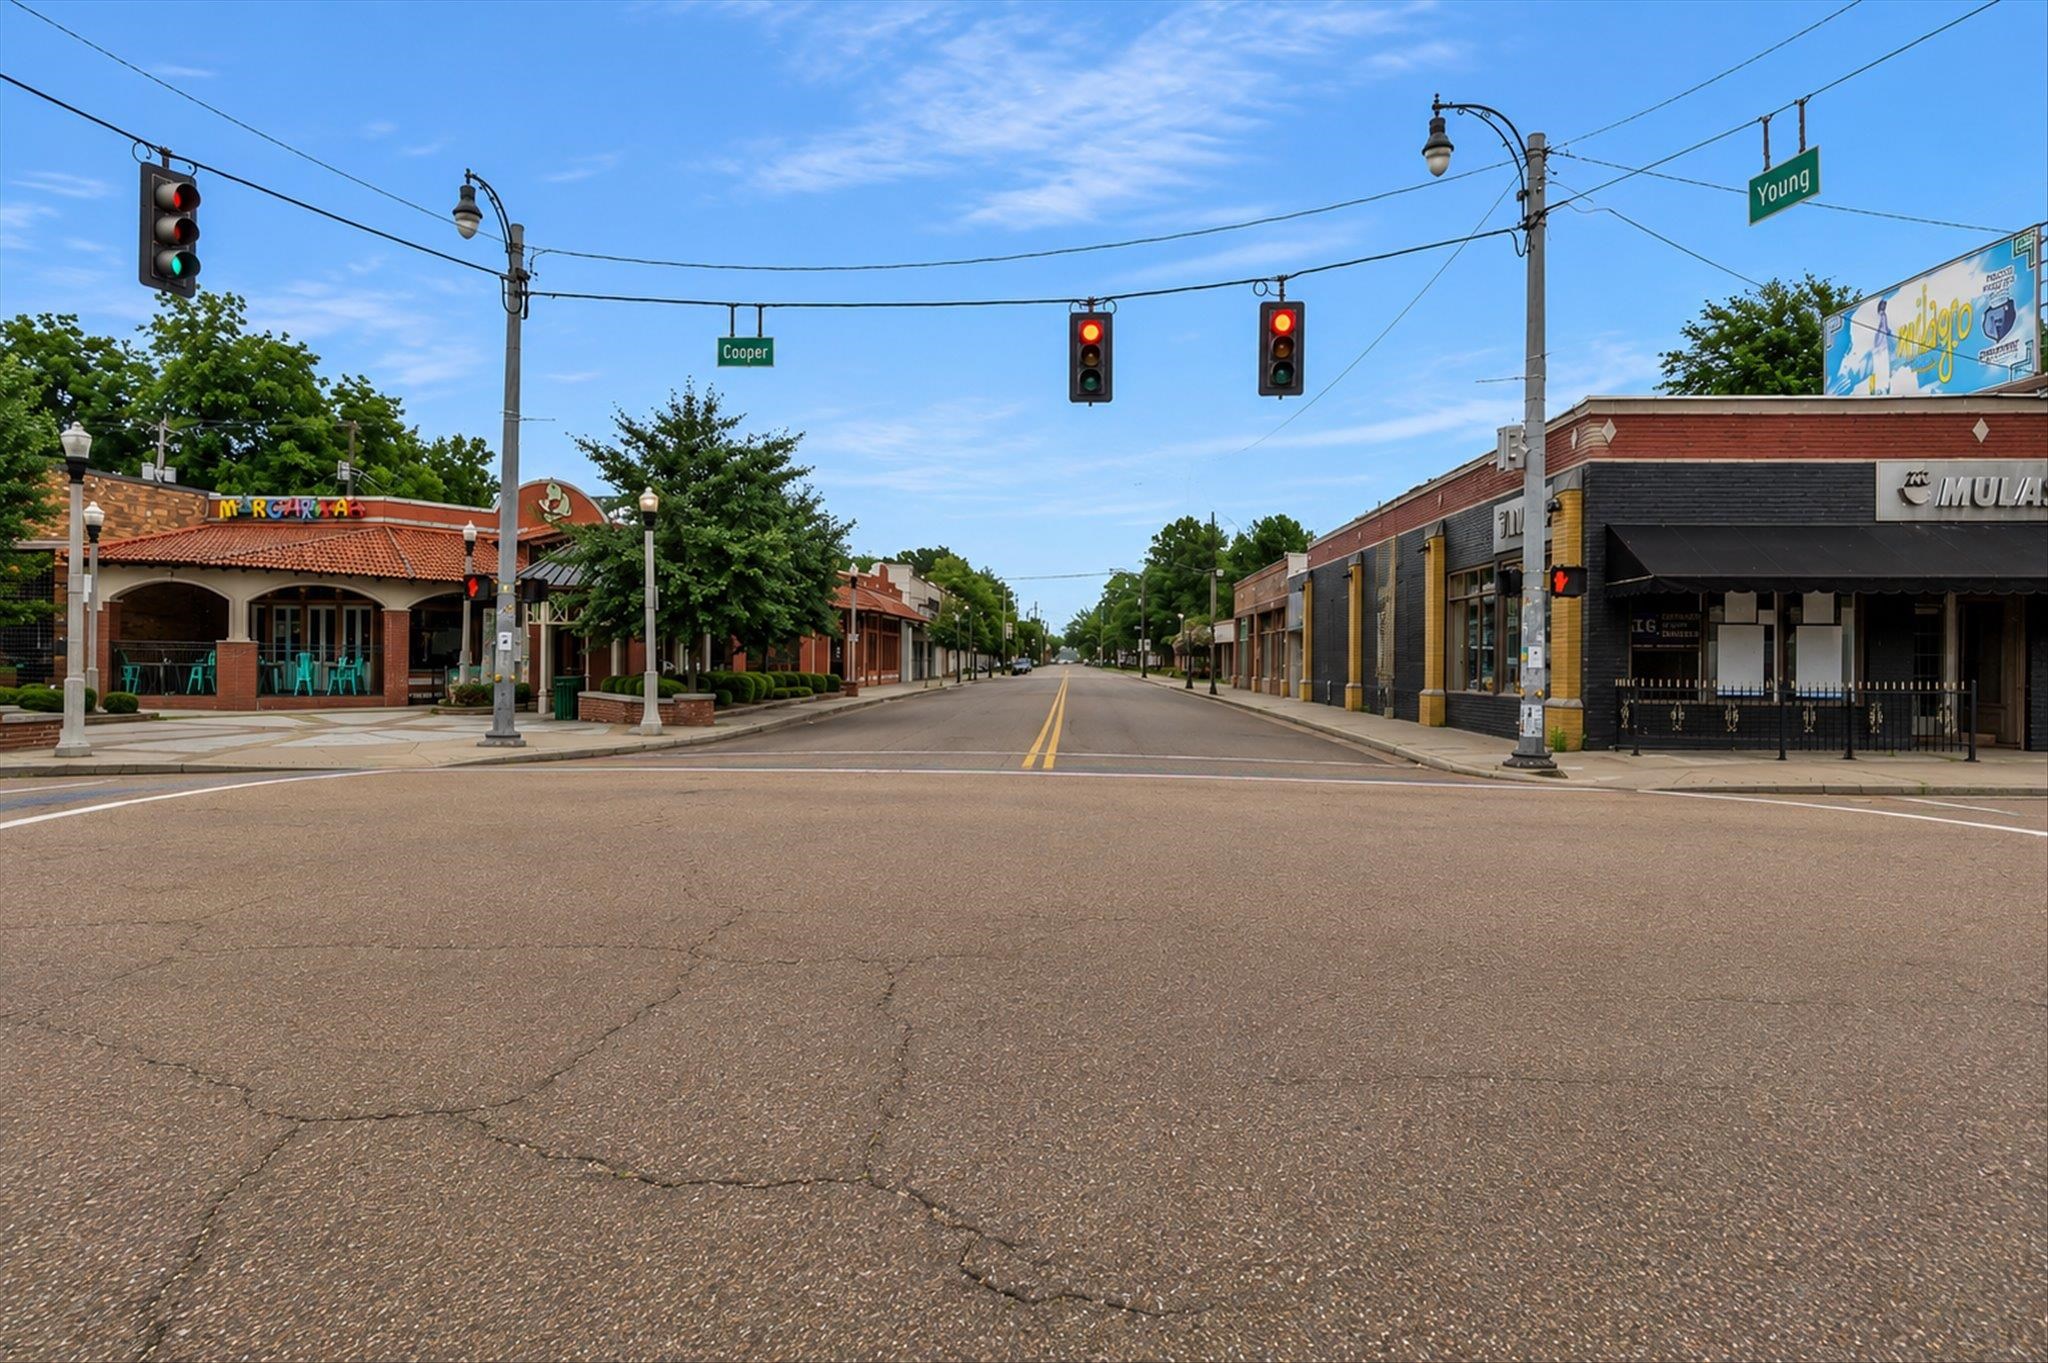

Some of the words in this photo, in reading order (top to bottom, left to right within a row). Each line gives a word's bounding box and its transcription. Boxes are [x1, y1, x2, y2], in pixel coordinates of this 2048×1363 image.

[1757, 168, 1810, 207] Young
[1896, 284, 1973, 384] milagro
[723, 344, 768, 363] Cooper
[1935, 476, 2047, 508] MULA
